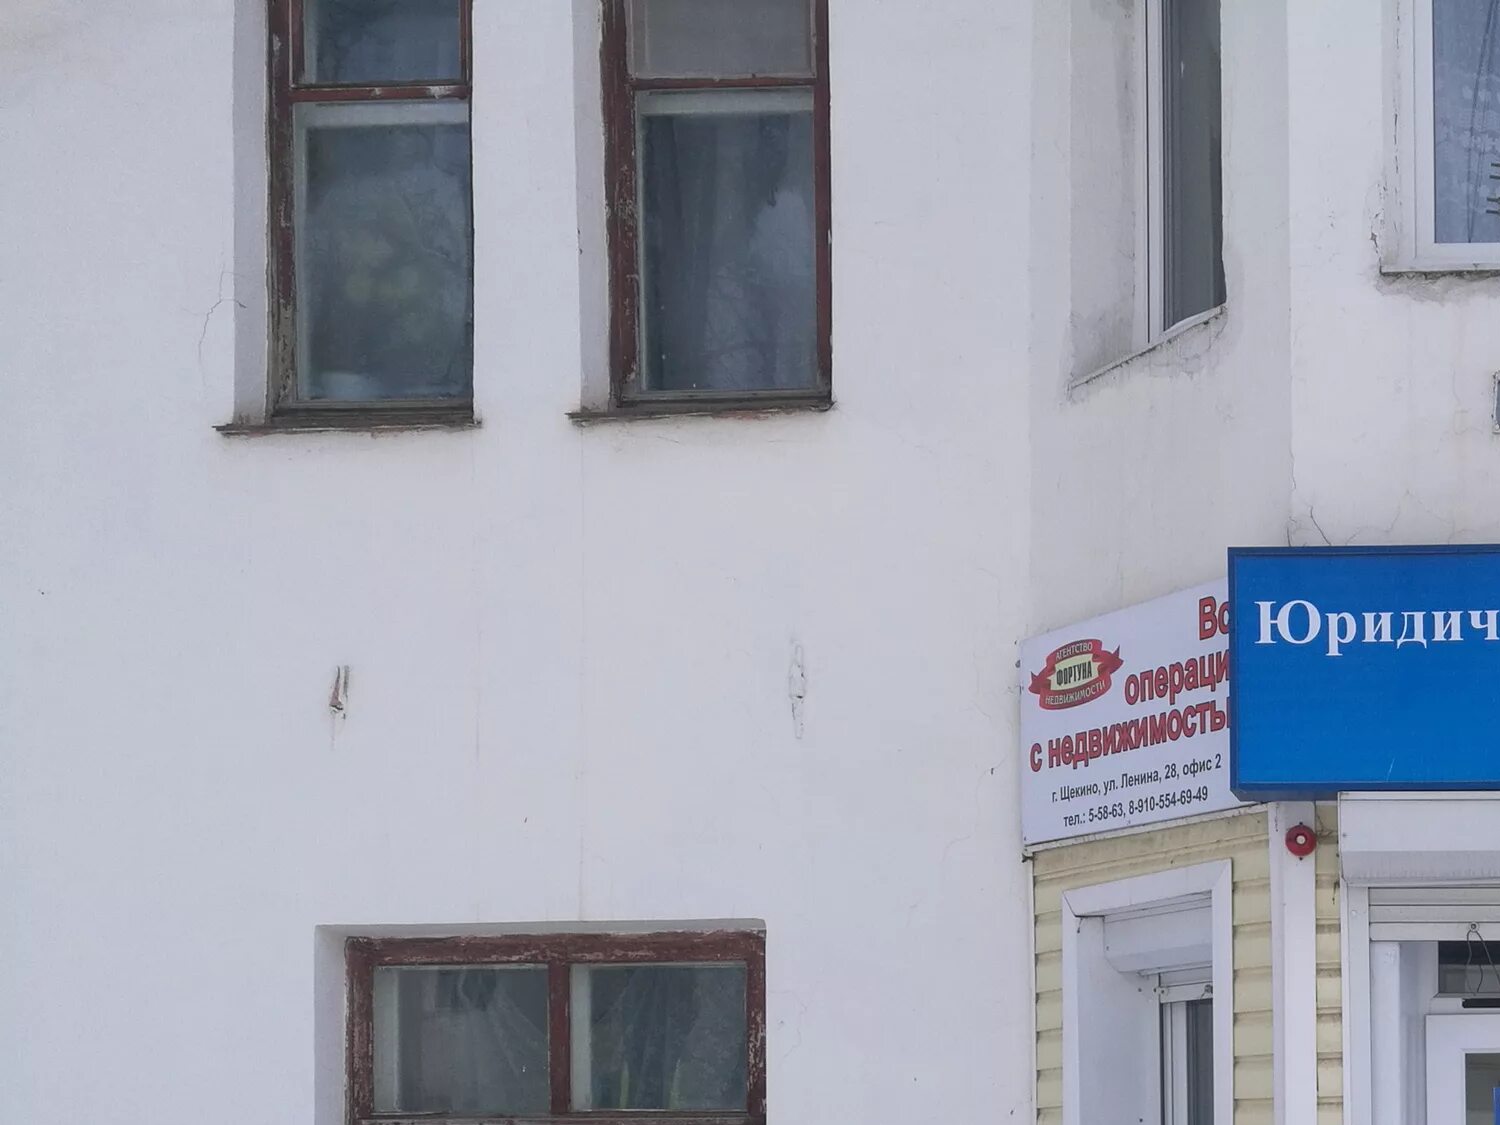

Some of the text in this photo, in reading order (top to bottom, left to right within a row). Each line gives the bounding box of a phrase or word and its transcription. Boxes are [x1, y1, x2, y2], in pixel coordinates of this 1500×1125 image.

[1055, 643, 1093, 660] АГЕНТСТВО
[1056, 661, 1092, 686] ФОРТУНА
[1045, 681, 1106, 705] НЕДВИЖИМОСТИ
[1030, 696, 1231, 773] с недвижимость
[1051, 753, 1222, 803] г. Щекино, ул. Ленина, 28, офис 2
[1063, 785, 1208, 827] тел.: 5-58-63, 8-910-554-69-49
